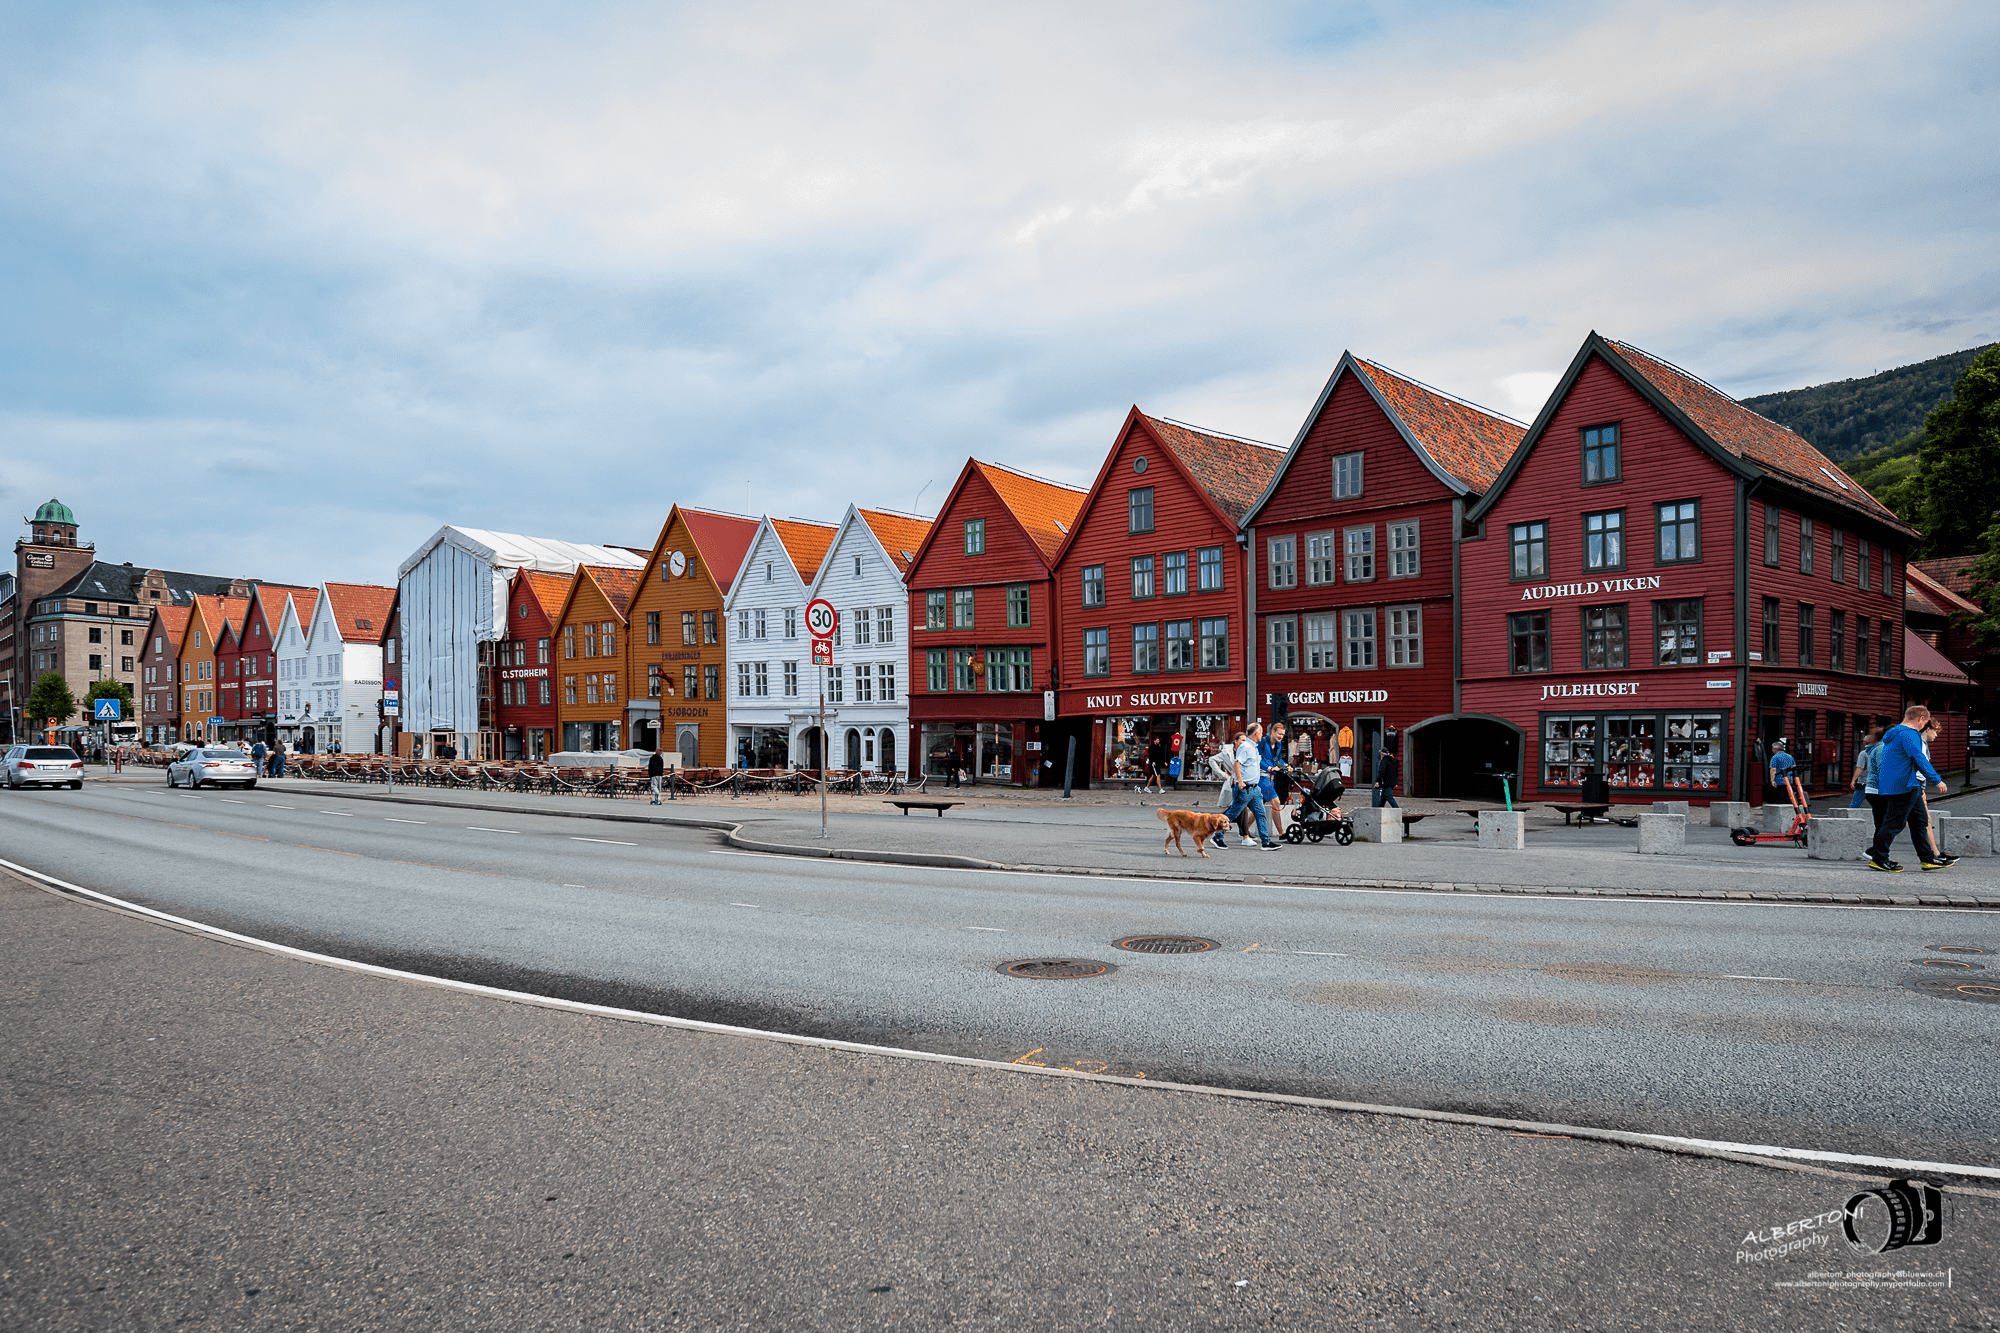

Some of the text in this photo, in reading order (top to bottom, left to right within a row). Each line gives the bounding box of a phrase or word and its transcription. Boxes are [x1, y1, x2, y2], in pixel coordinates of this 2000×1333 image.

[1521, 576, 1661, 600] AUDHILD VIKEN
[811, 608, 832, 628] 30
[1328, 689, 1389, 704] HUSFLID
[1540, 682, 1640, 701] JULEHUSET
[1796, 683, 1828, 698] JULEHUSET
[1087, 691, 1214, 708] KNUT SKURTVEIT
[667, 707, 709, 717] SJØBODEN
